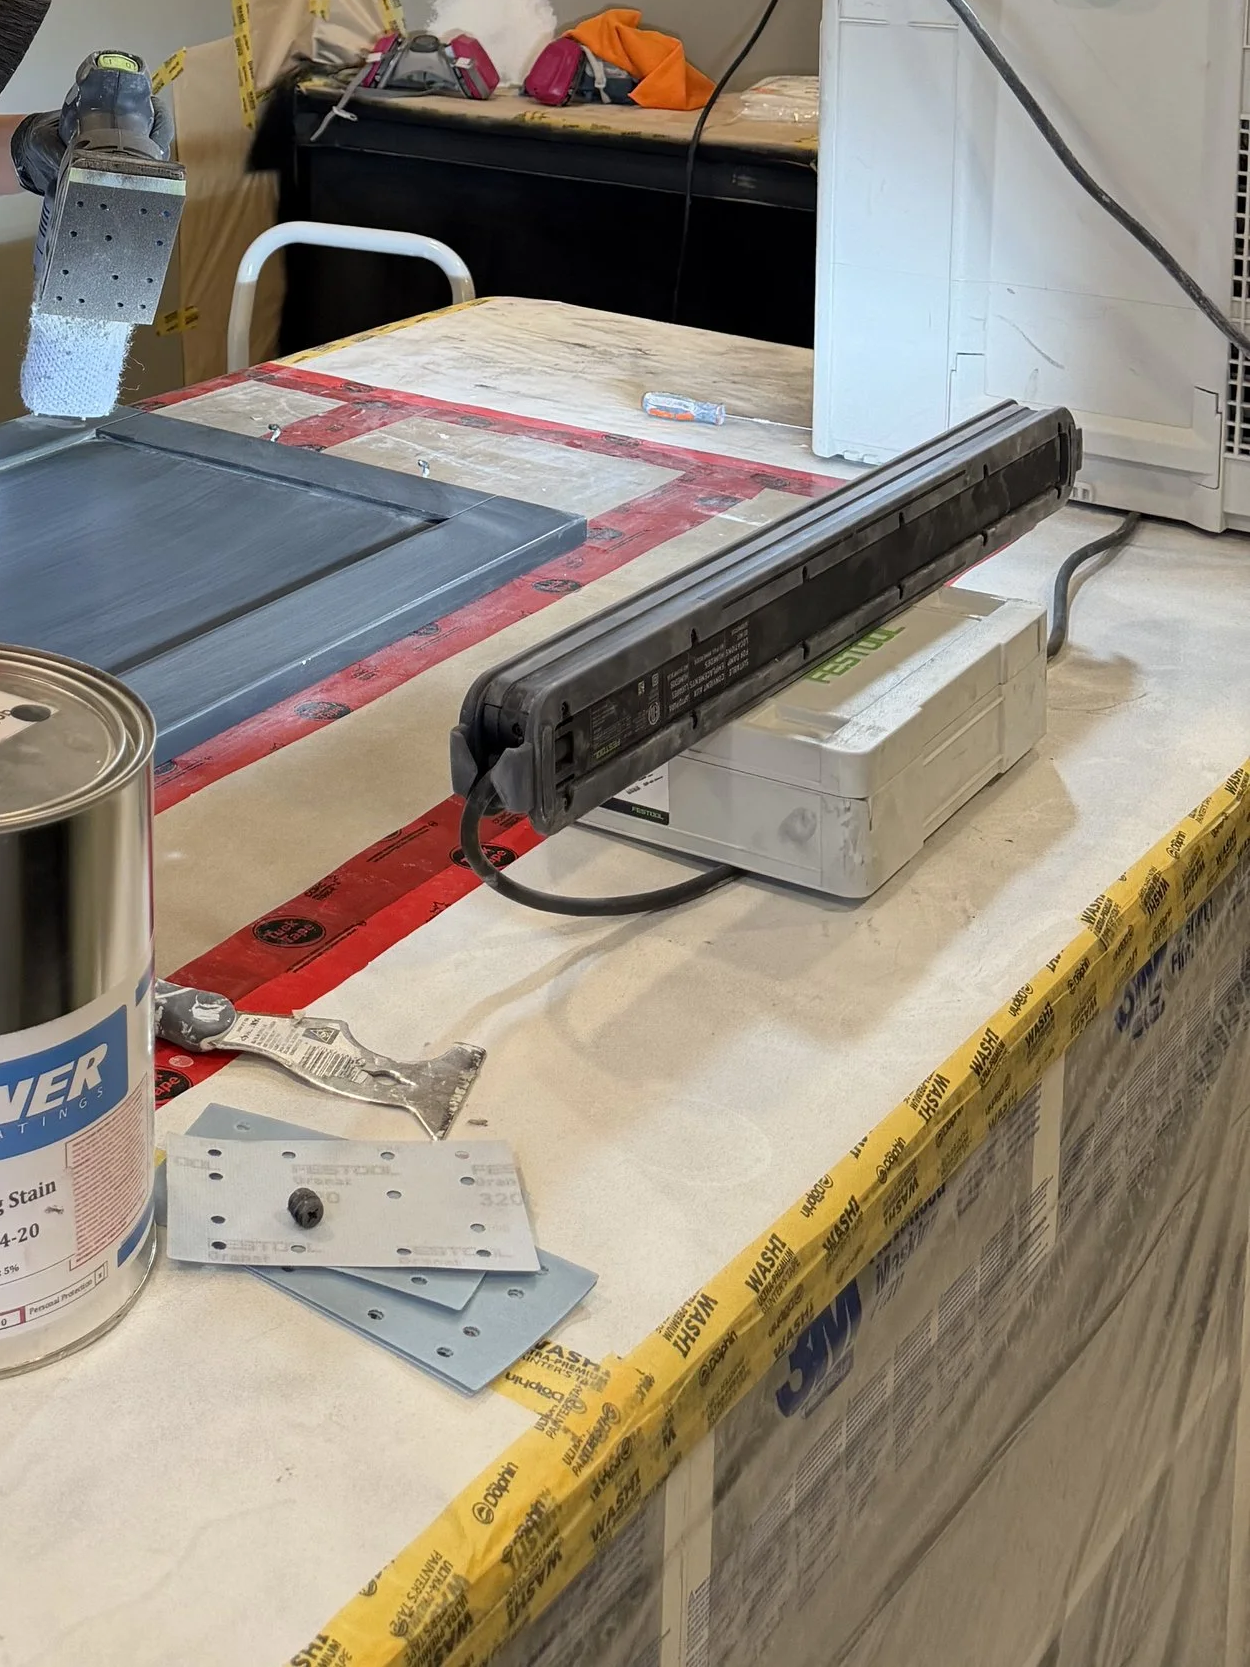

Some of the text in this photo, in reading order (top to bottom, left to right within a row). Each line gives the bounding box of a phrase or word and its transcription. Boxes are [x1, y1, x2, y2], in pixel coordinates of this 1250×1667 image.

[805, 627, 906, 684] FESTOOL
[1025, 1002, 1054, 1045] WASHI
[970, 1027, 999, 1076] WASHI
[155, 1076, 181, 1097] ape
[917, 1073, 950, 1124] WASHI
[8, 1180, 57, 1210] Stain
[822, 1195, 861, 1254] WASHI
[4, 1264, 20, 1276] 5%
[744, 1233, 787, 1294] WASHI
[1, 1318, 7, 1327] 0
[28, 1280, 94, 1317] Personal Protection
[673, 1292, 718, 1359] WASHI
[708, 1329, 738, 1372] Dolphin
[484, 1461, 519, 1509] Dolphin
[591, 1468, 641, 1543] WASHI
[406, 1549, 444, 1607] PAINTER'S
